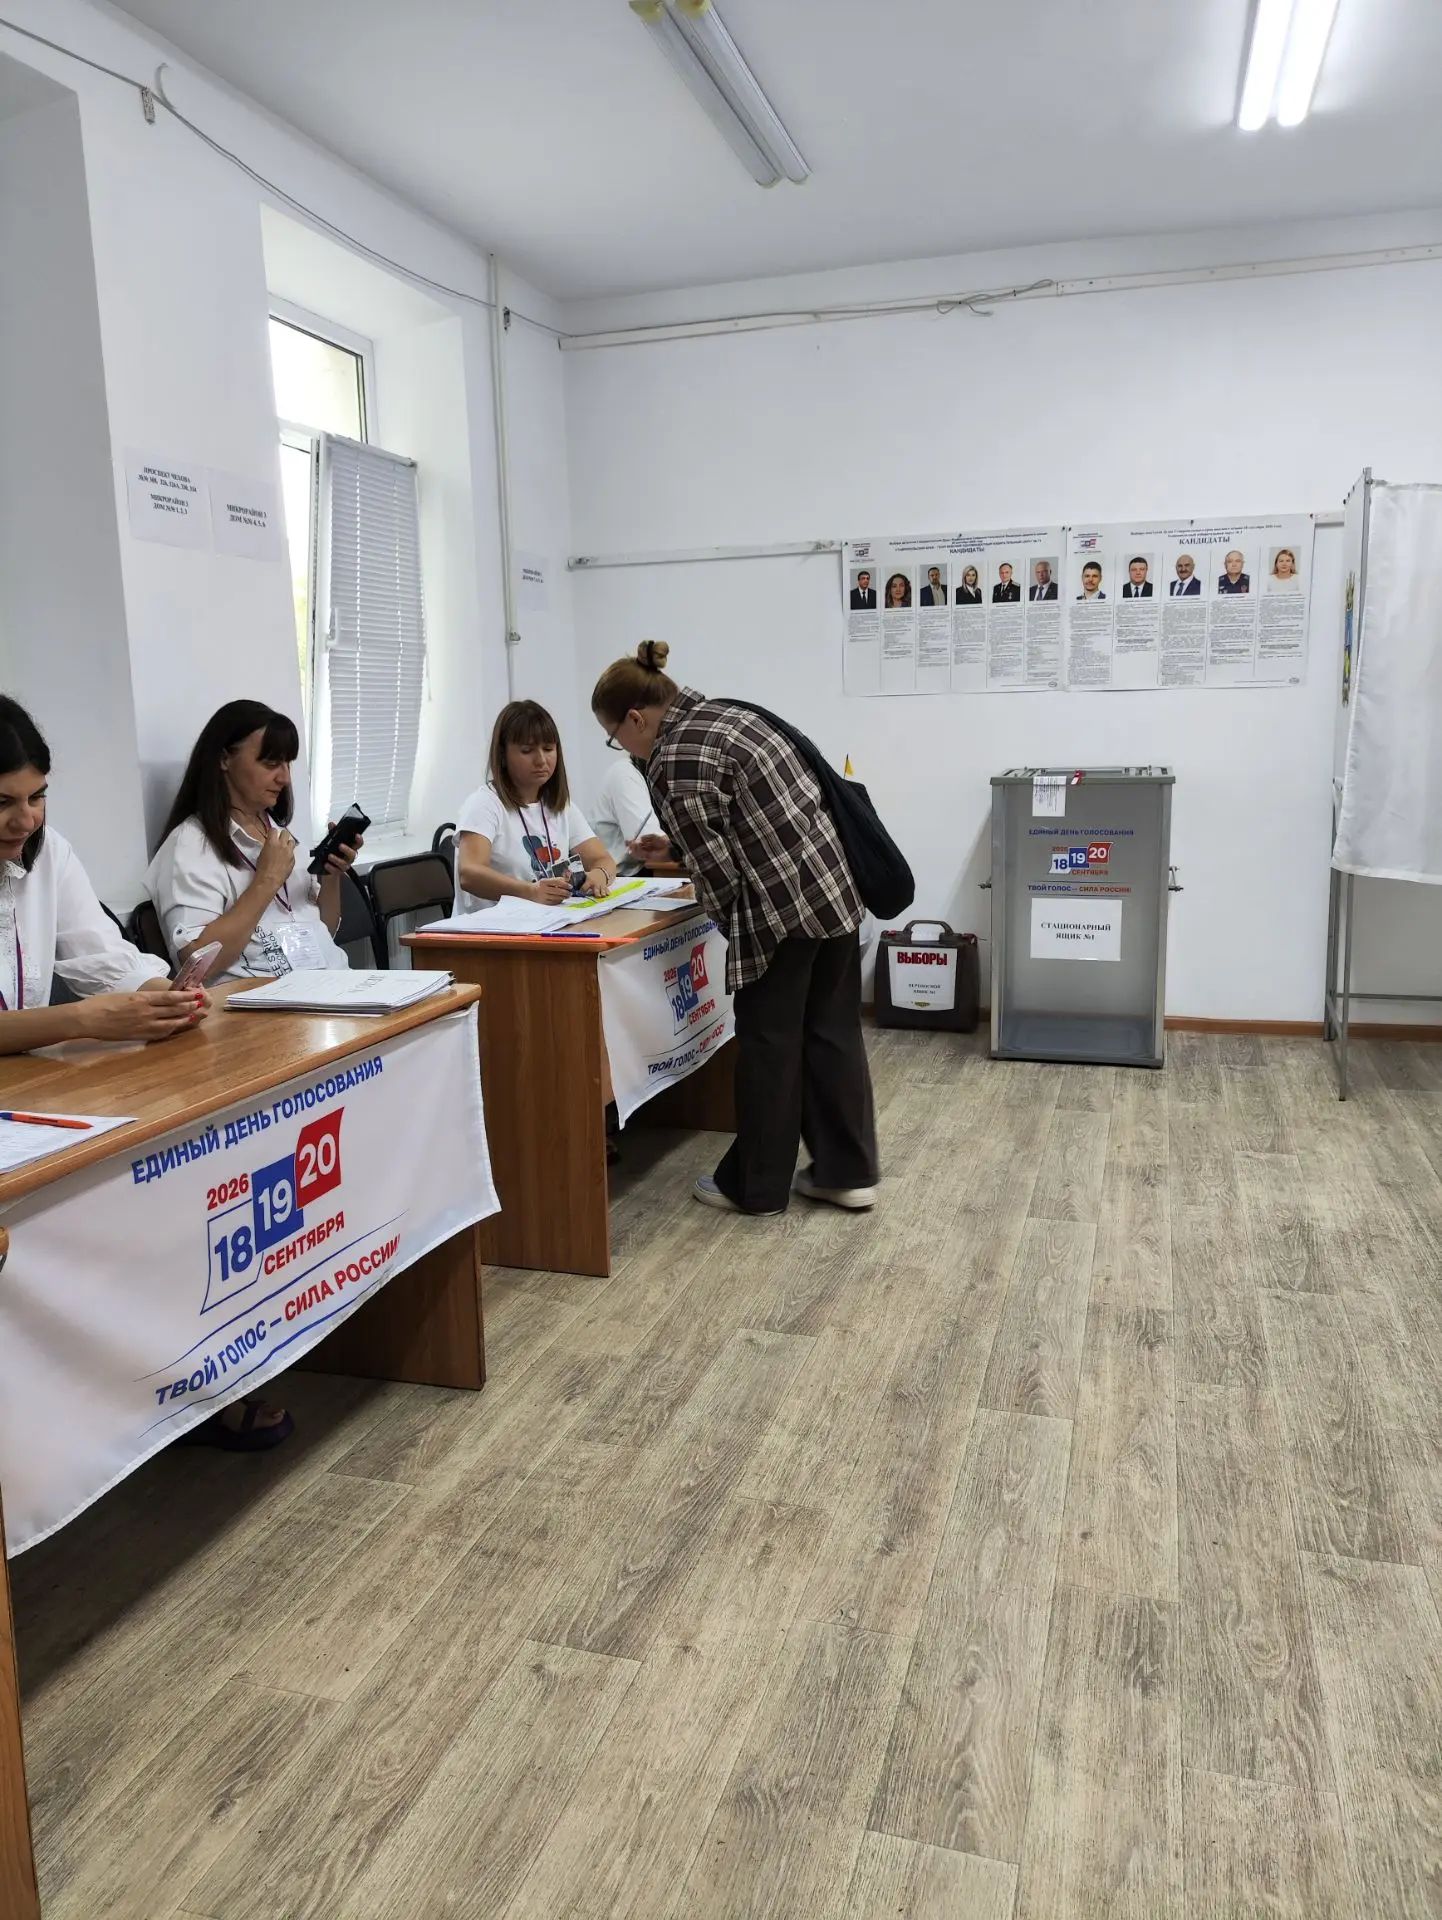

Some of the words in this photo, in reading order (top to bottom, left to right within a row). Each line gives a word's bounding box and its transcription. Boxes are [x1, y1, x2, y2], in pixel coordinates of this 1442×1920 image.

[1180, 537, 1230, 545] КАНДИДАТЫ
[1053, 859, 1068, 870] 18
[1071, 853, 1085, 864] 19
[1089, 847, 1107, 859] 20
[1041, 922, 1111, 931] СТАЦИОНАРНЫЙ
[1056, 933, 1082, 941] ЯЩИК
[644, 938, 670, 961] ЕДИНЫЙ
[670, 937, 684, 952] ДЕНЬ
[897, 952, 947, 965] ВЫБОРЫ
[664, 967, 678, 982] 2026
[672, 995, 685, 1021] 18
[680, 974, 693, 1000] 19
[692, 954, 705, 980] 20
[688, 999, 715, 1024] СЕНТЯБРЯ
[648, 1057, 673, 1075] ТВОЙ
[674, 1049, 695, 1067] ГОЛОС
[131, 1125, 221, 1185] ЕДИНЫЙ
[224, 1111, 272, 1149] ДЕНЬ
[272, 1056, 383, 1124] ГОЛОСОВАНИЯ
[206, 1173, 249, 1211] 2026
[214, 1225, 253, 1281] 18
[258, 1179, 293, 1231] 19
[298, 1133, 337, 1189] 20
[264, 1211, 345, 1275] СЕНТЯБРЯ
[155, 1355, 218, 1405] ТВОЙ
[217, 1319, 267, 1373] ГОЛОС
[284, 1279, 334, 1322] СИЛА
